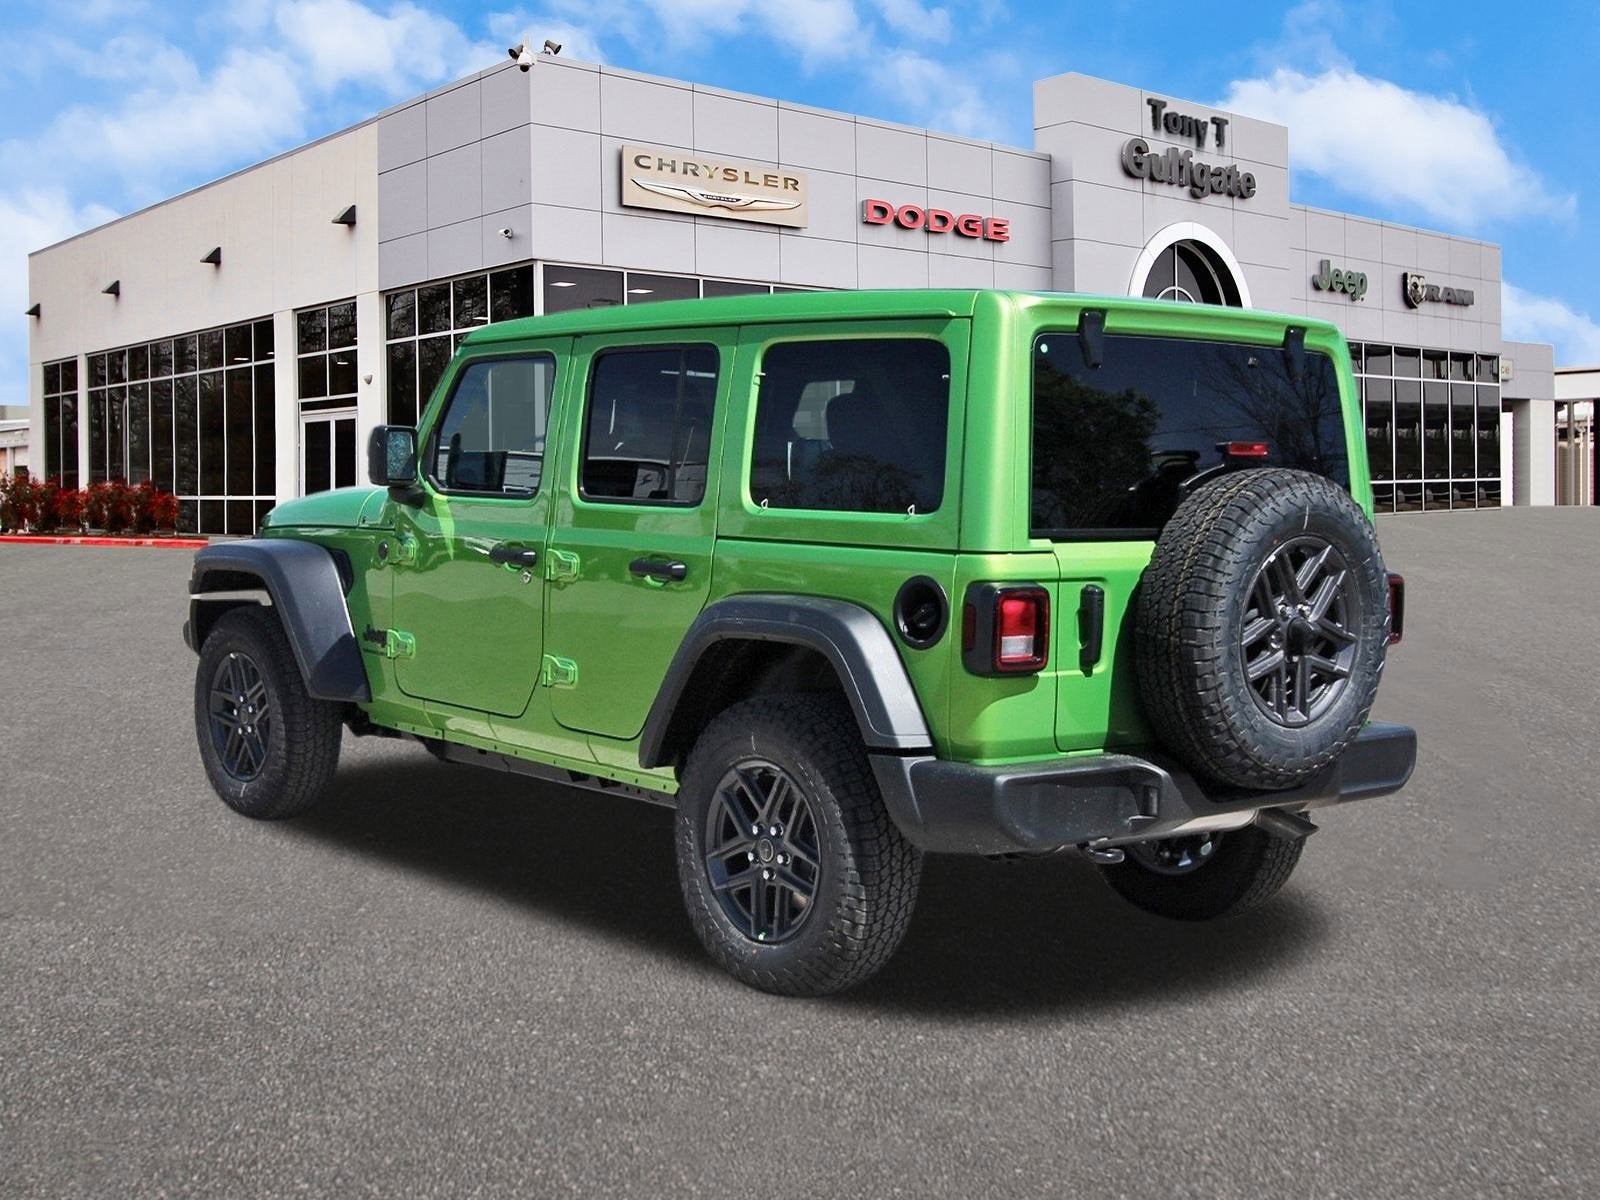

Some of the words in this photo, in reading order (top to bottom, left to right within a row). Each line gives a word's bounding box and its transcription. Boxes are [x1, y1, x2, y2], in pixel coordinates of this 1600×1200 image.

[1147, 98, 1208, 147] Tony
[1211, 116, 1229, 147] T
[633, 154, 800, 192] CHRYSLER
[1121, 137, 1256, 199] Gulfgate
[862, 199, 1010, 243] DODGE
[1312, 259, 1368, 302] Jeep
[1425, 284, 1474, 306] RAM
